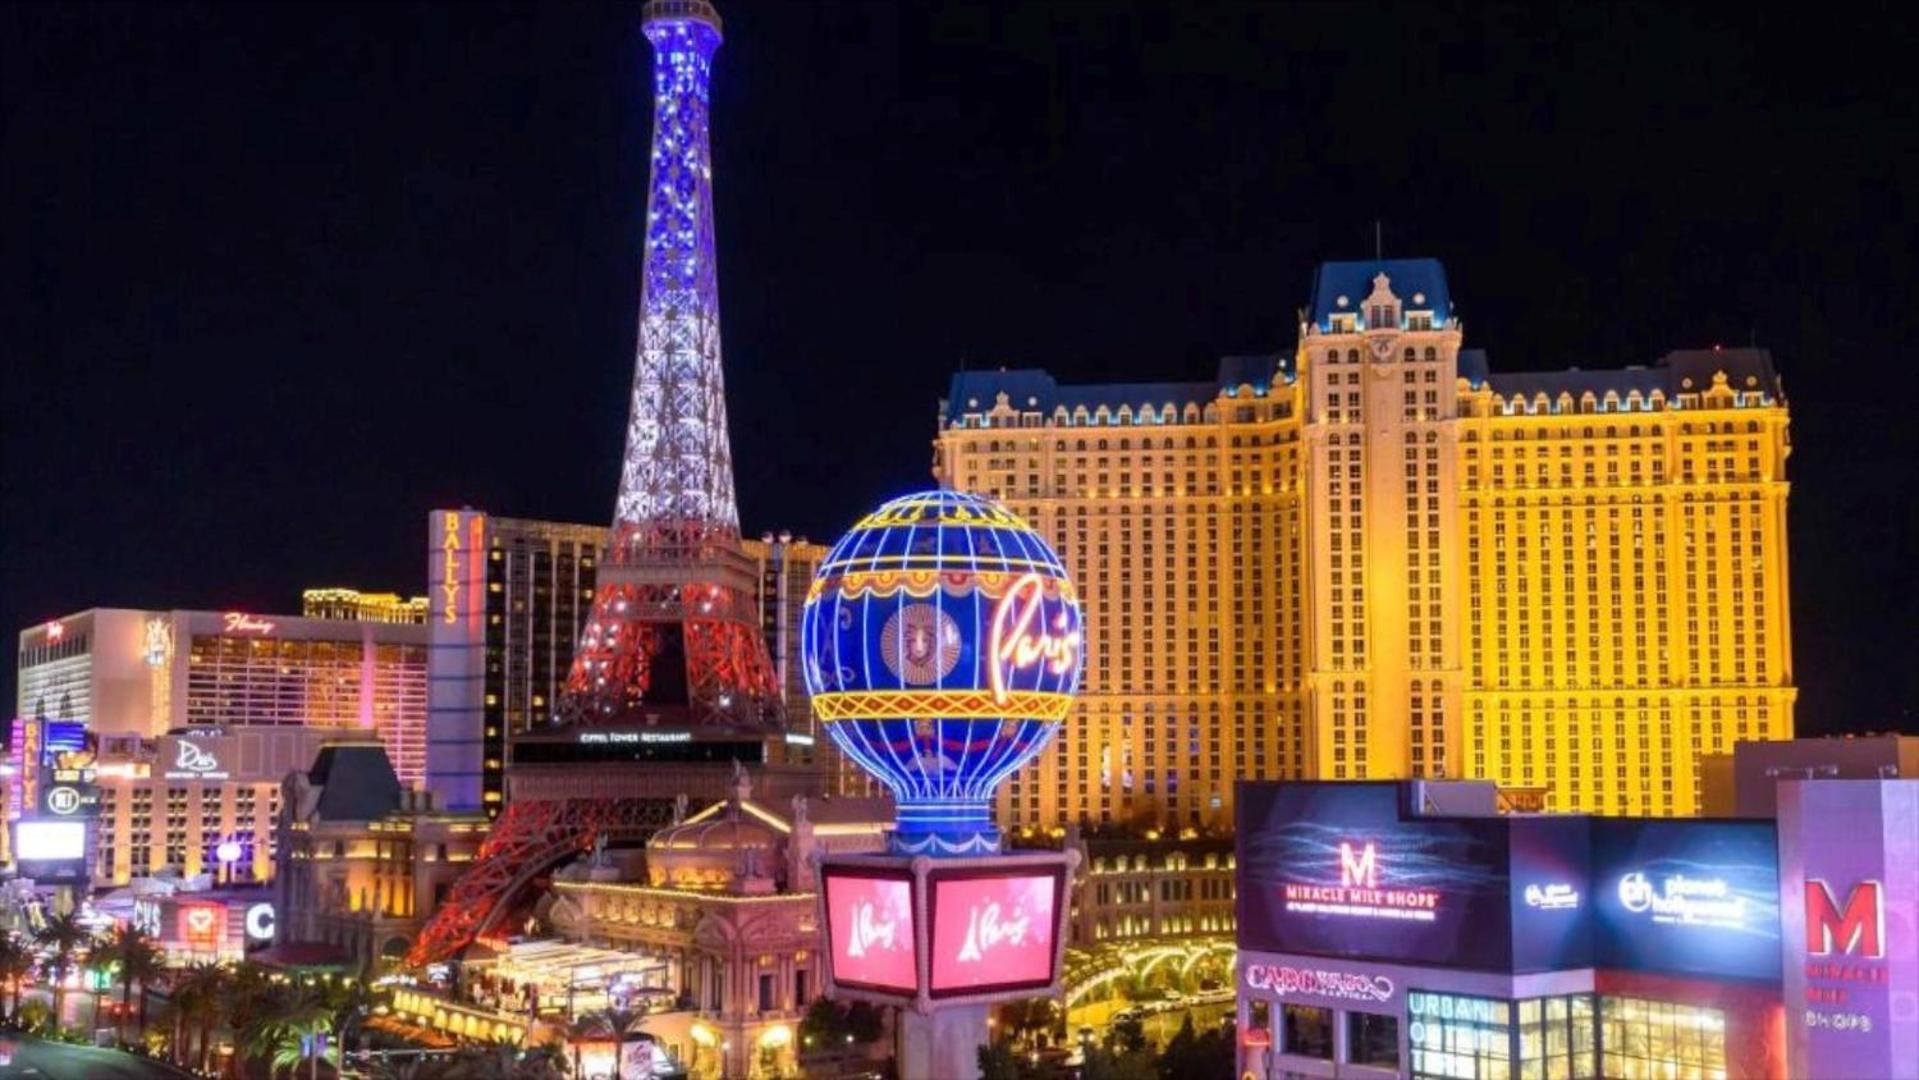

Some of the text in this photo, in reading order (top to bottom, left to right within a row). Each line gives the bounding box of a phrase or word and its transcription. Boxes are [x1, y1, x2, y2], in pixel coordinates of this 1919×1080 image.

[991, 573, 1080, 704] Paris
[1286, 885, 1345, 902] MIRACLE
[1350, 887, 1382, 904] MILE
[1804, 878, 1885, 959] M
[1409, 992, 1489, 1022] URBAN
